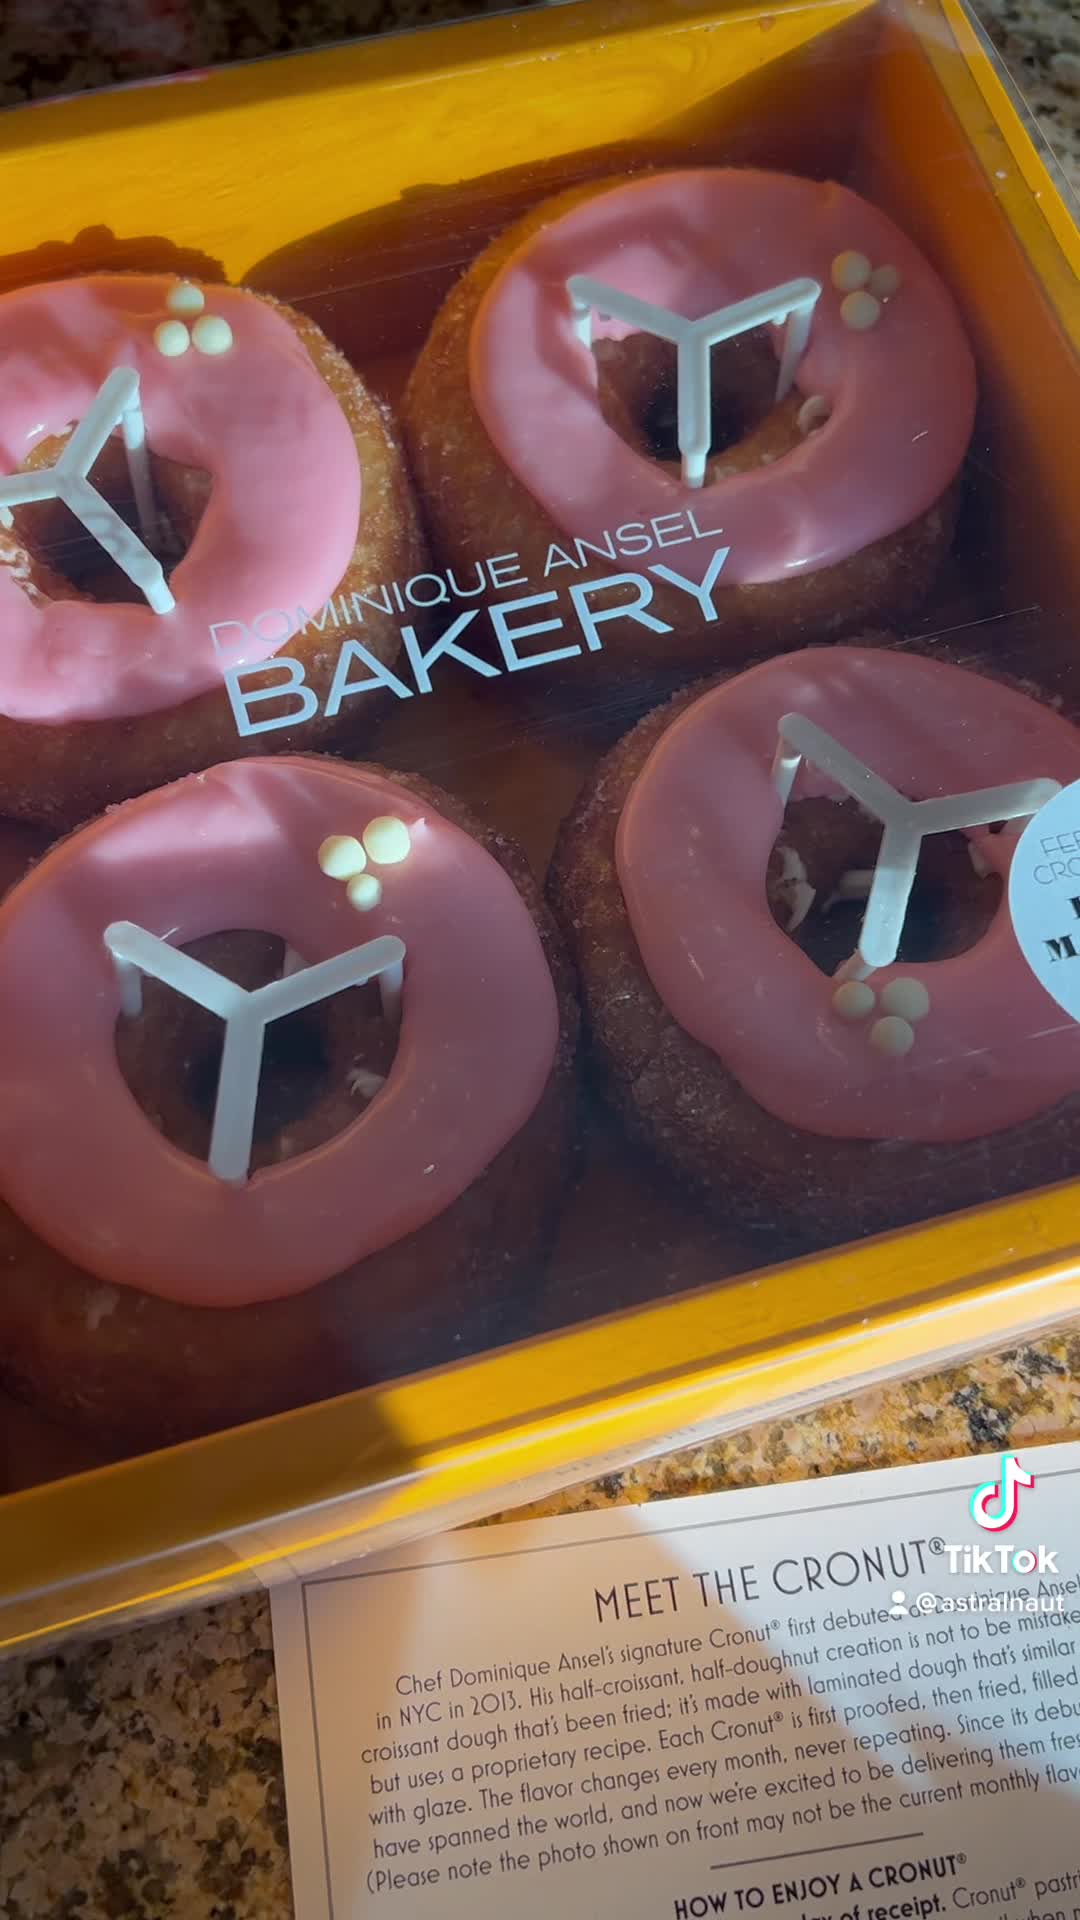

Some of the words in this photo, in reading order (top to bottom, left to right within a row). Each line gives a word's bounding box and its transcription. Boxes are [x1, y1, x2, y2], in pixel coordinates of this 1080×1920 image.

[209, 552, 529, 658] DOMINIQUE
[544, 510, 723, 577] ANSEL
[224, 547, 730, 737] BAKERY
[594, 1577, 679, 1623] MEET
[691, 1565, 760, 1607] THE
[360, 1735, 439, 1763] croissant
[446, 1722, 507, 1750] dough
[513, 1714, 559, 1741] that's
[564, 1711, 616, 1732] been
[621, 1697, 672, 1724] fried;
[678, 1693, 698, 1715] it's
[704, 1685, 760, 1711] made
[765, 1677, 802, 1700] with
[807, 1661, 902, 1695] laminated
[907, 1651, 967, 1679] dough
[972, 1643, 1016, 1669] that's
[1021, 1637, 1075, 1662] similar
[375, 1712, 391, 1730] in
[399, 1701, 442, 1727] NYC
[448, 1700, 464, 1719] in
[469, 1689, 522, 1716] 2013.
[529, 1685, 554, 1707] His
[559, 1667, 684, 1702] half-croissant,
[689, 1645, 819, 1682] half-doughnut
[825, 1636, 903, 1661] creation
[907, 1631, 919, 1648] is
[925, 1624, 954, 1646] not
[959, 1623, 980, 1640] to
[983, 1616, 1011, 1636] be
[395, 1669, 442, 1695] Chef
[449, 1660, 550, 1688] Dominique
[557, 1644, 614, 1672] Ansel's
[620, 1637, 702, 1665] signature
[787, 1615, 815, 1637] first
[368, 1801, 405, 1826] with
[412, 1797, 472, 1825] glaze.
[477, 1787, 513, 1809] The
[519, 1781, 573, 1803] flavor
[580, 1767, 660, 1793] changes
[666, 1759, 717, 1780] every
[724, 1743, 787, 1771] month,
[794, 1738, 846, 1760] never
[853, 1721, 951, 1752] repeating.
[956, 1713, 1004, 1734] Since
[1010, 1706, 1028, 1726] its
[369, 1771, 400, 1794] but
[407, 1769, 444, 1789] uses
[451, 1767, 464, 1781] a
[471, 1748, 576, 1784] proprietary
[583, 1737, 651, 1762] recipe.
[657, 1723, 704, 1749] Each
[790, 1711, 803, 1728] is
[807, 1705, 836, 1726] first
[843, 1689, 925, 1726] proofed,
[931, 1686, 972, 1706] then
[977, 1673, 1026, 1699] fried,
[1031, 1664, 1078, 1691] filled
[366, 1868, 440, 1894] (Please
[447, 1857, 492, 1880] note
[498, 1849, 530, 1872] the
[537, 1841, 596, 1872] photo
[602, 1833, 659, 1856] shown
[665, 1828, 690, 1845] on
[695, 1815, 739, 1840] front
[746, 1813, 784, 1833] may
[791, 1802, 822, 1825] not
[827, 1799, 855, 1819] be
[860, 1791, 892, 1814] the
[898, 1779, 962, 1808] current
[969, 1767, 1039, 1797] monthly
[1045, 1763, 1080, 1784] flav
[372, 1837, 421, 1858] have
[427, 1816, 510, 1855] spanned
[516, 1814, 548, 1836] the
[553, 1801, 613, 1829] world,
[620, 1793, 657, 1820] and
[664, 1793, 703, 1813] now
[708, 1780, 757, 1805] we're
[764, 1765, 835, 1797] excited
[840, 1766, 861, 1784] to
[866, 1759, 894, 1781] be
[901, 1746, 993, 1775] delivering
[998, 1738, 1045, 1760] them
[673, 1890, 727, 1920] HOW
[733, 1886, 764, 1911] TO
[771, 1872, 840, 1904] ENJOY
[848, 1871, 863, 1893] A
[866, 1892, 946, 1920] receipt.
